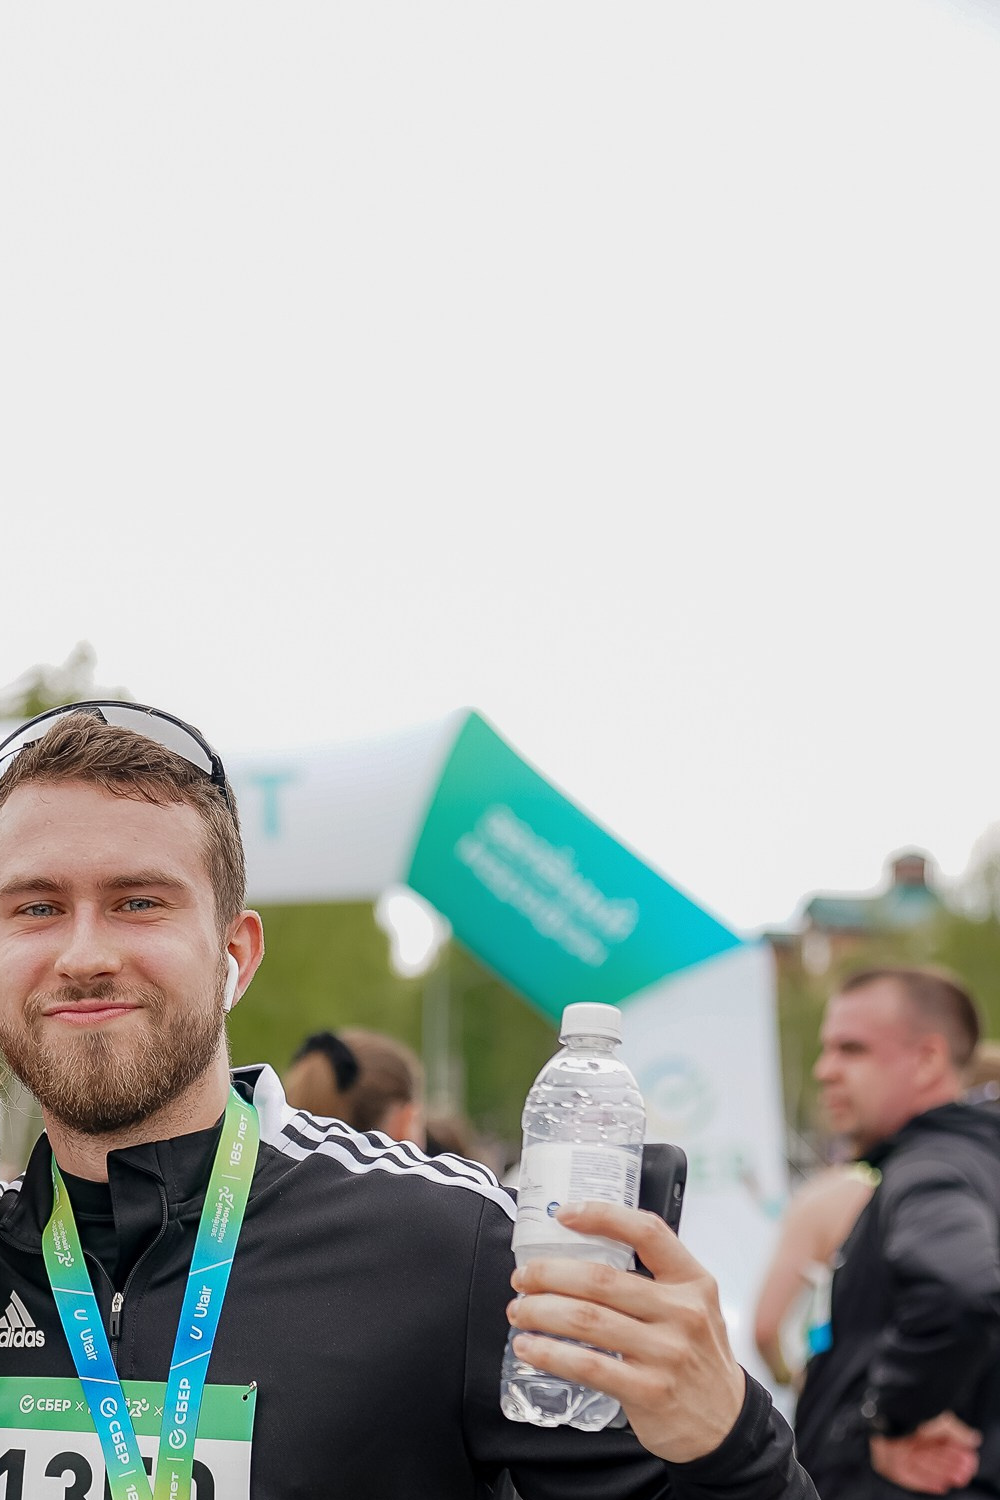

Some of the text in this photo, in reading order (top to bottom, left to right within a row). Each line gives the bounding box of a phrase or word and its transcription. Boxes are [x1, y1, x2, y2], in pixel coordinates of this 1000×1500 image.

[230, 1114, 249, 1167] 185 лет
[217, 1207, 230, 1243] марафон
[194, 1285, 213, 1318] Utair
[80, 1328, 98, 1361] Utair
[36, 1398, 72, 1412] СБЕР
[174, 1377, 191, 1424] СБЕР
[109, 1420, 130, 1465] СБЕР
